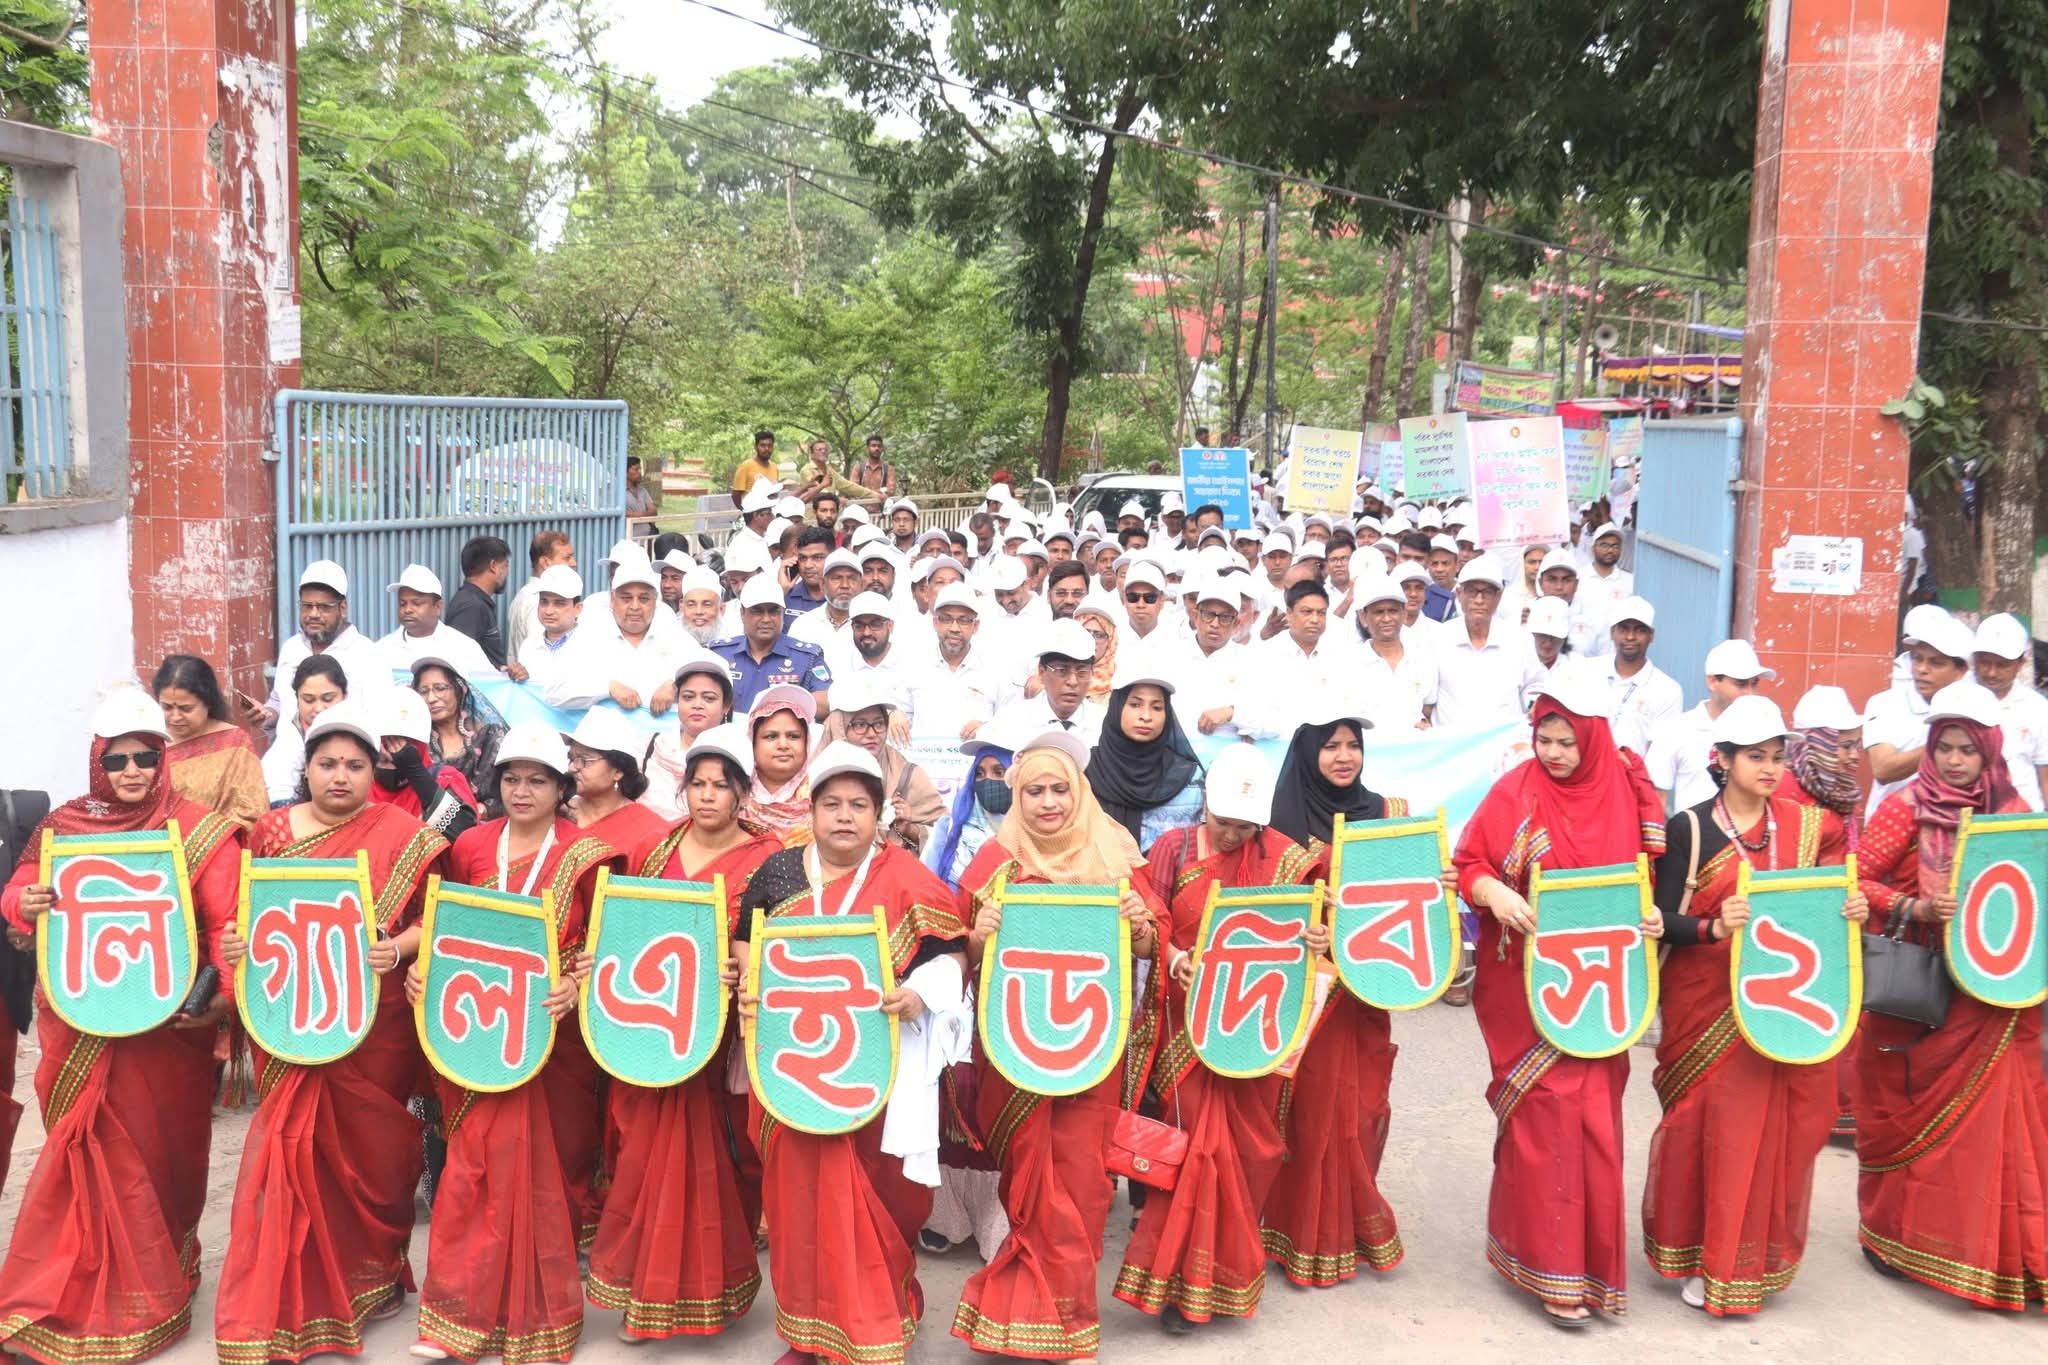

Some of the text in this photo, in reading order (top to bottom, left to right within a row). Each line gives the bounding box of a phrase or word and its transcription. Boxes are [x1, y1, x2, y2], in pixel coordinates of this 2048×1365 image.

[1222, 486, 1241, 497] দিবস
[1416, 469, 1440, 478] সরকার
[1419, 456, 1450, 466] বাংলাদেশ
[51, 855, 178, 999] লি
[250, 890, 366, 1037] গ্যা
[1192, 909, 1305, 1055] দি
[1339, 878, 1442, 990] ব
[1534, 926, 1641, 1037] স
[1740, 915, 1839, 1035] ২
[1961, 860, 2038, 980] ০
[433, 935, 548, 1068] ল
[595, 932, 701, 1060] এ
[762, 938, 884, 1115] ই
[1000, 948, 1113, 1077] ড
